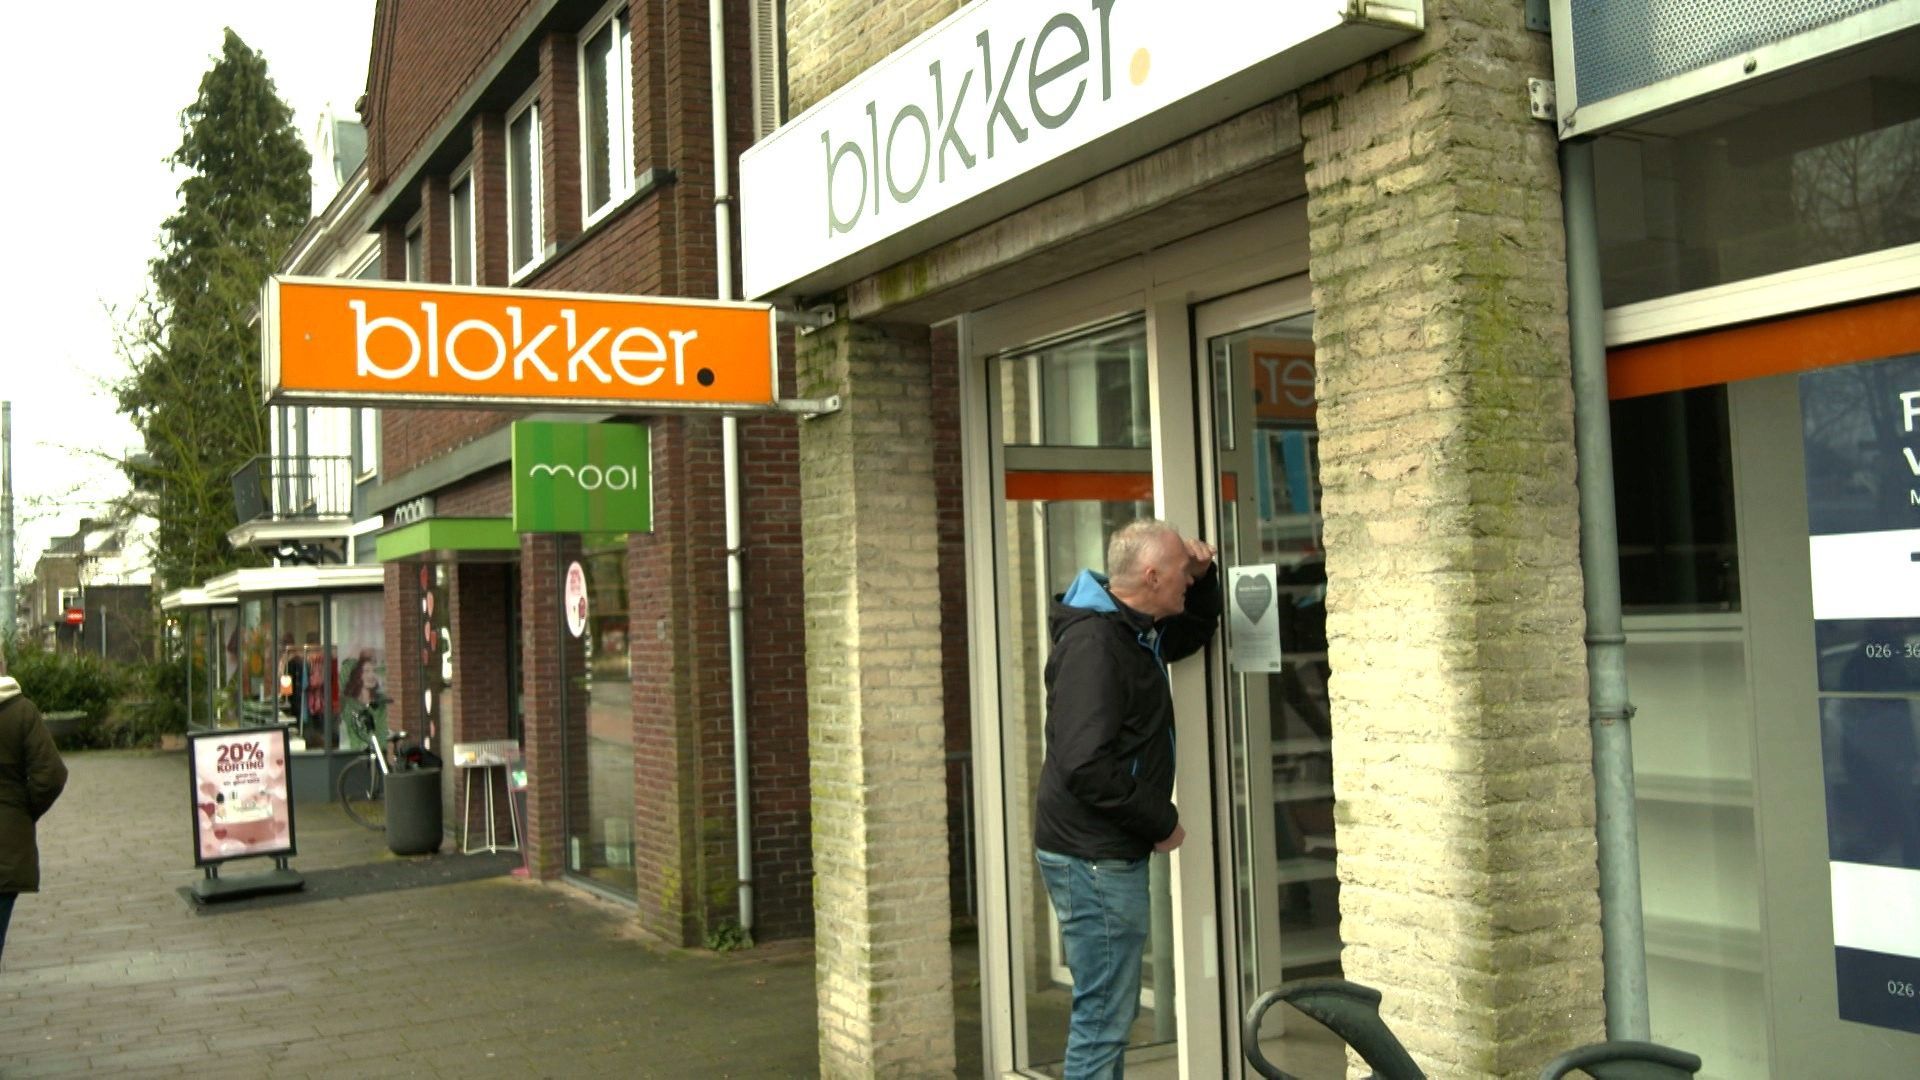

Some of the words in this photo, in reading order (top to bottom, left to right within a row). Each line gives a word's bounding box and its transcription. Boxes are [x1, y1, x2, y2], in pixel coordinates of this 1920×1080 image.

[348, 299, 714, 387] blokker.
[1866, 644, 1892, 658] 026
[217, 742, 264, 764] 20%
[217, 760, 264, 773] KORTING
[1887, 980, 1915, 998] 026
